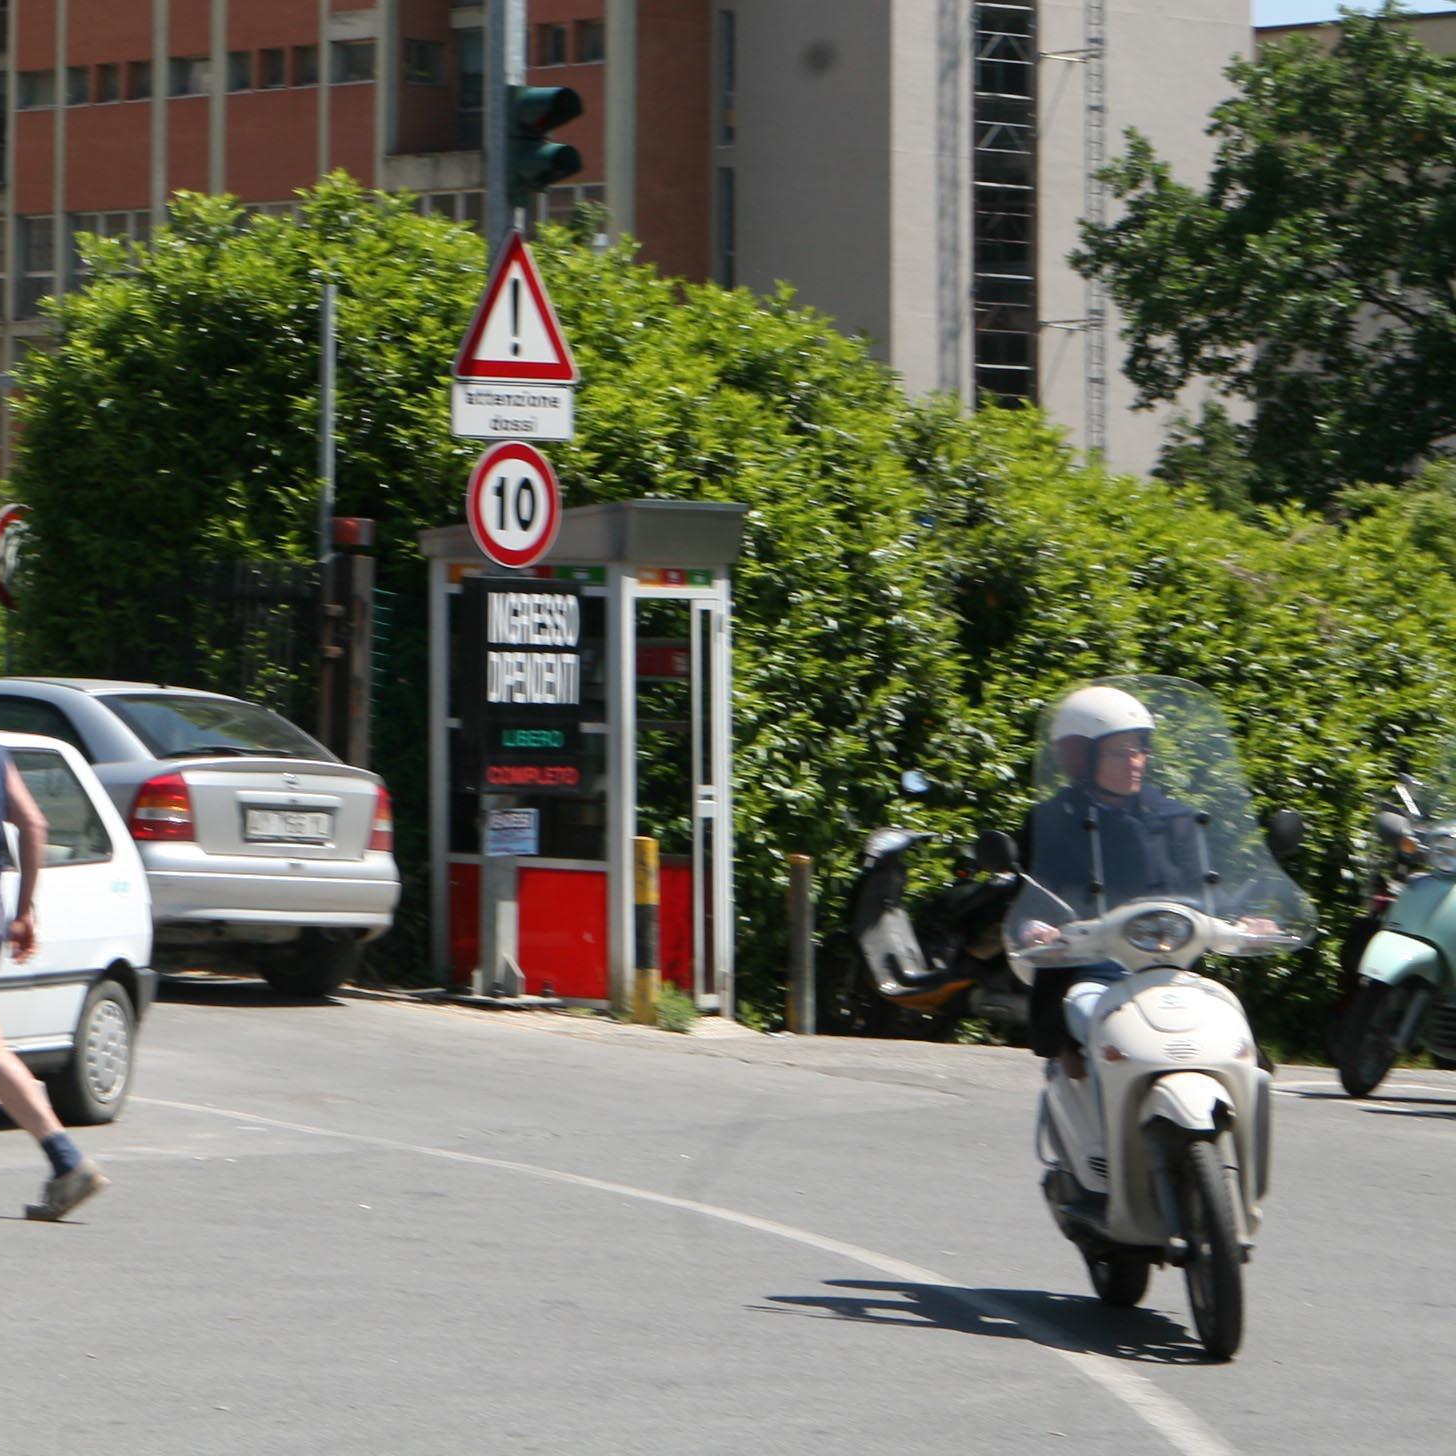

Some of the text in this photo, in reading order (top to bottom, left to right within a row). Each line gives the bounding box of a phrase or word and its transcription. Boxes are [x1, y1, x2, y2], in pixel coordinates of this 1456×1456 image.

[465, 390, 561, 408] attenzione
[489, 416, 537, 432] dossi
[492, 476, 536, 531] 10
[487, 592, 581, 647] INGRESSO
